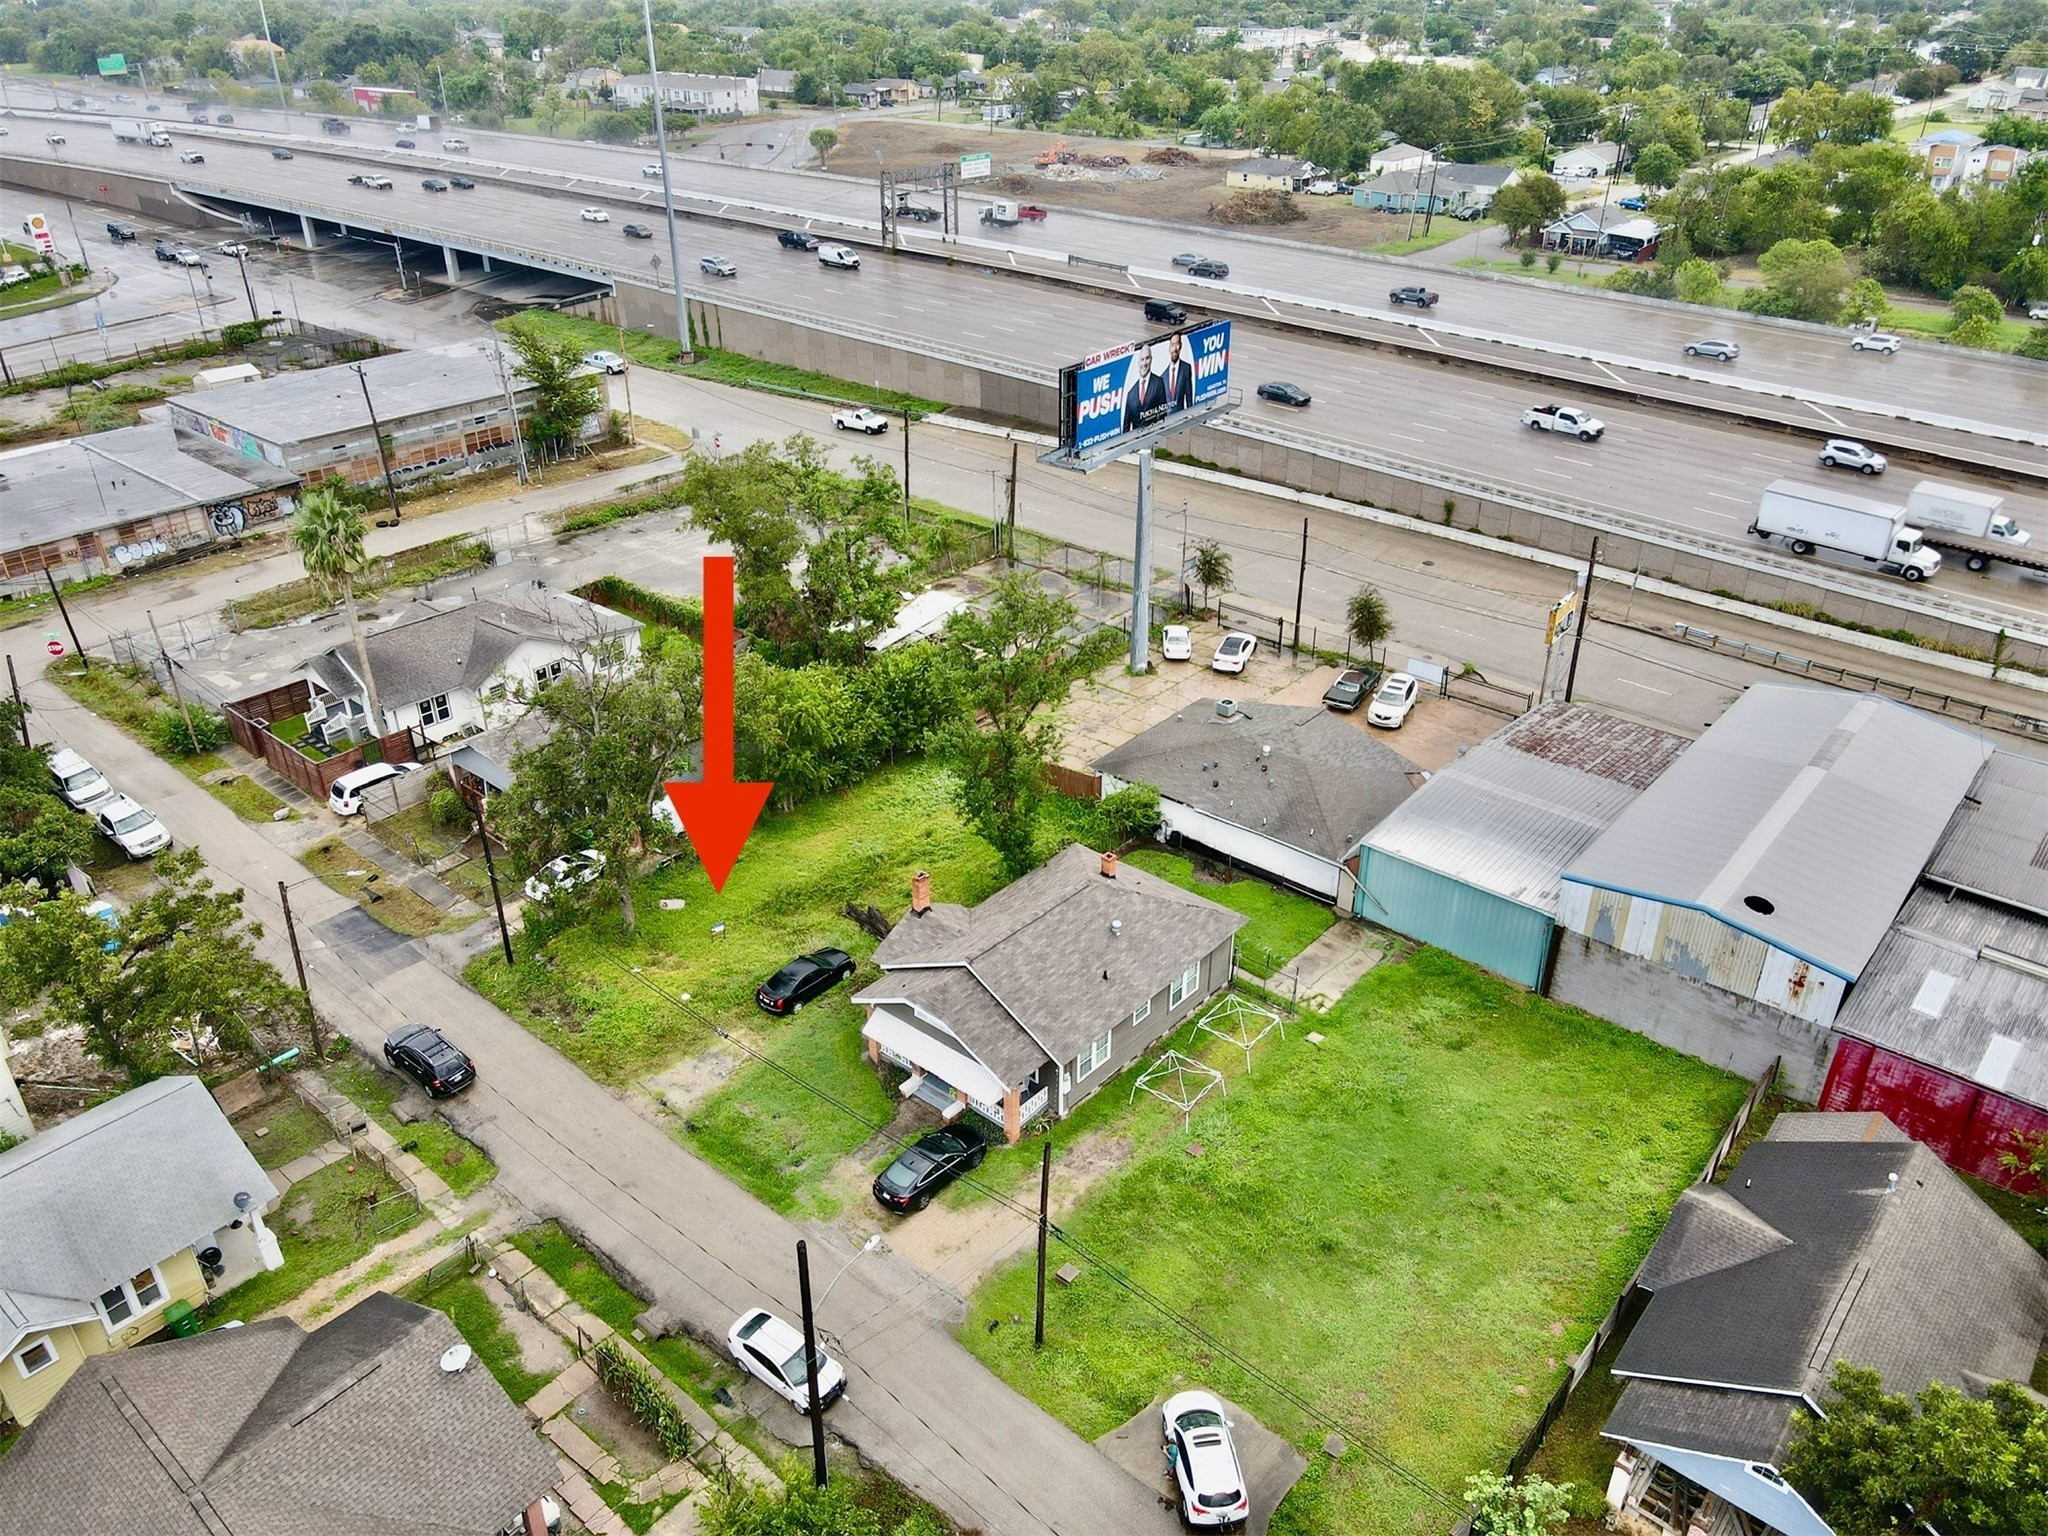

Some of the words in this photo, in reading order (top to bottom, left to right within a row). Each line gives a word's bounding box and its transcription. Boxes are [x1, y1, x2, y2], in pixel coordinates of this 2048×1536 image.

[1086, 355, 1101, 366] CAR
[1103, 342, 1134, 360] WRECK?
[1203, 332, 1224, 353] YOU
[1198, 349, 1226, 379] WIN
[1093, 374, 1110, 393] WE
[1078, 387, 1122, 424] PUSH
